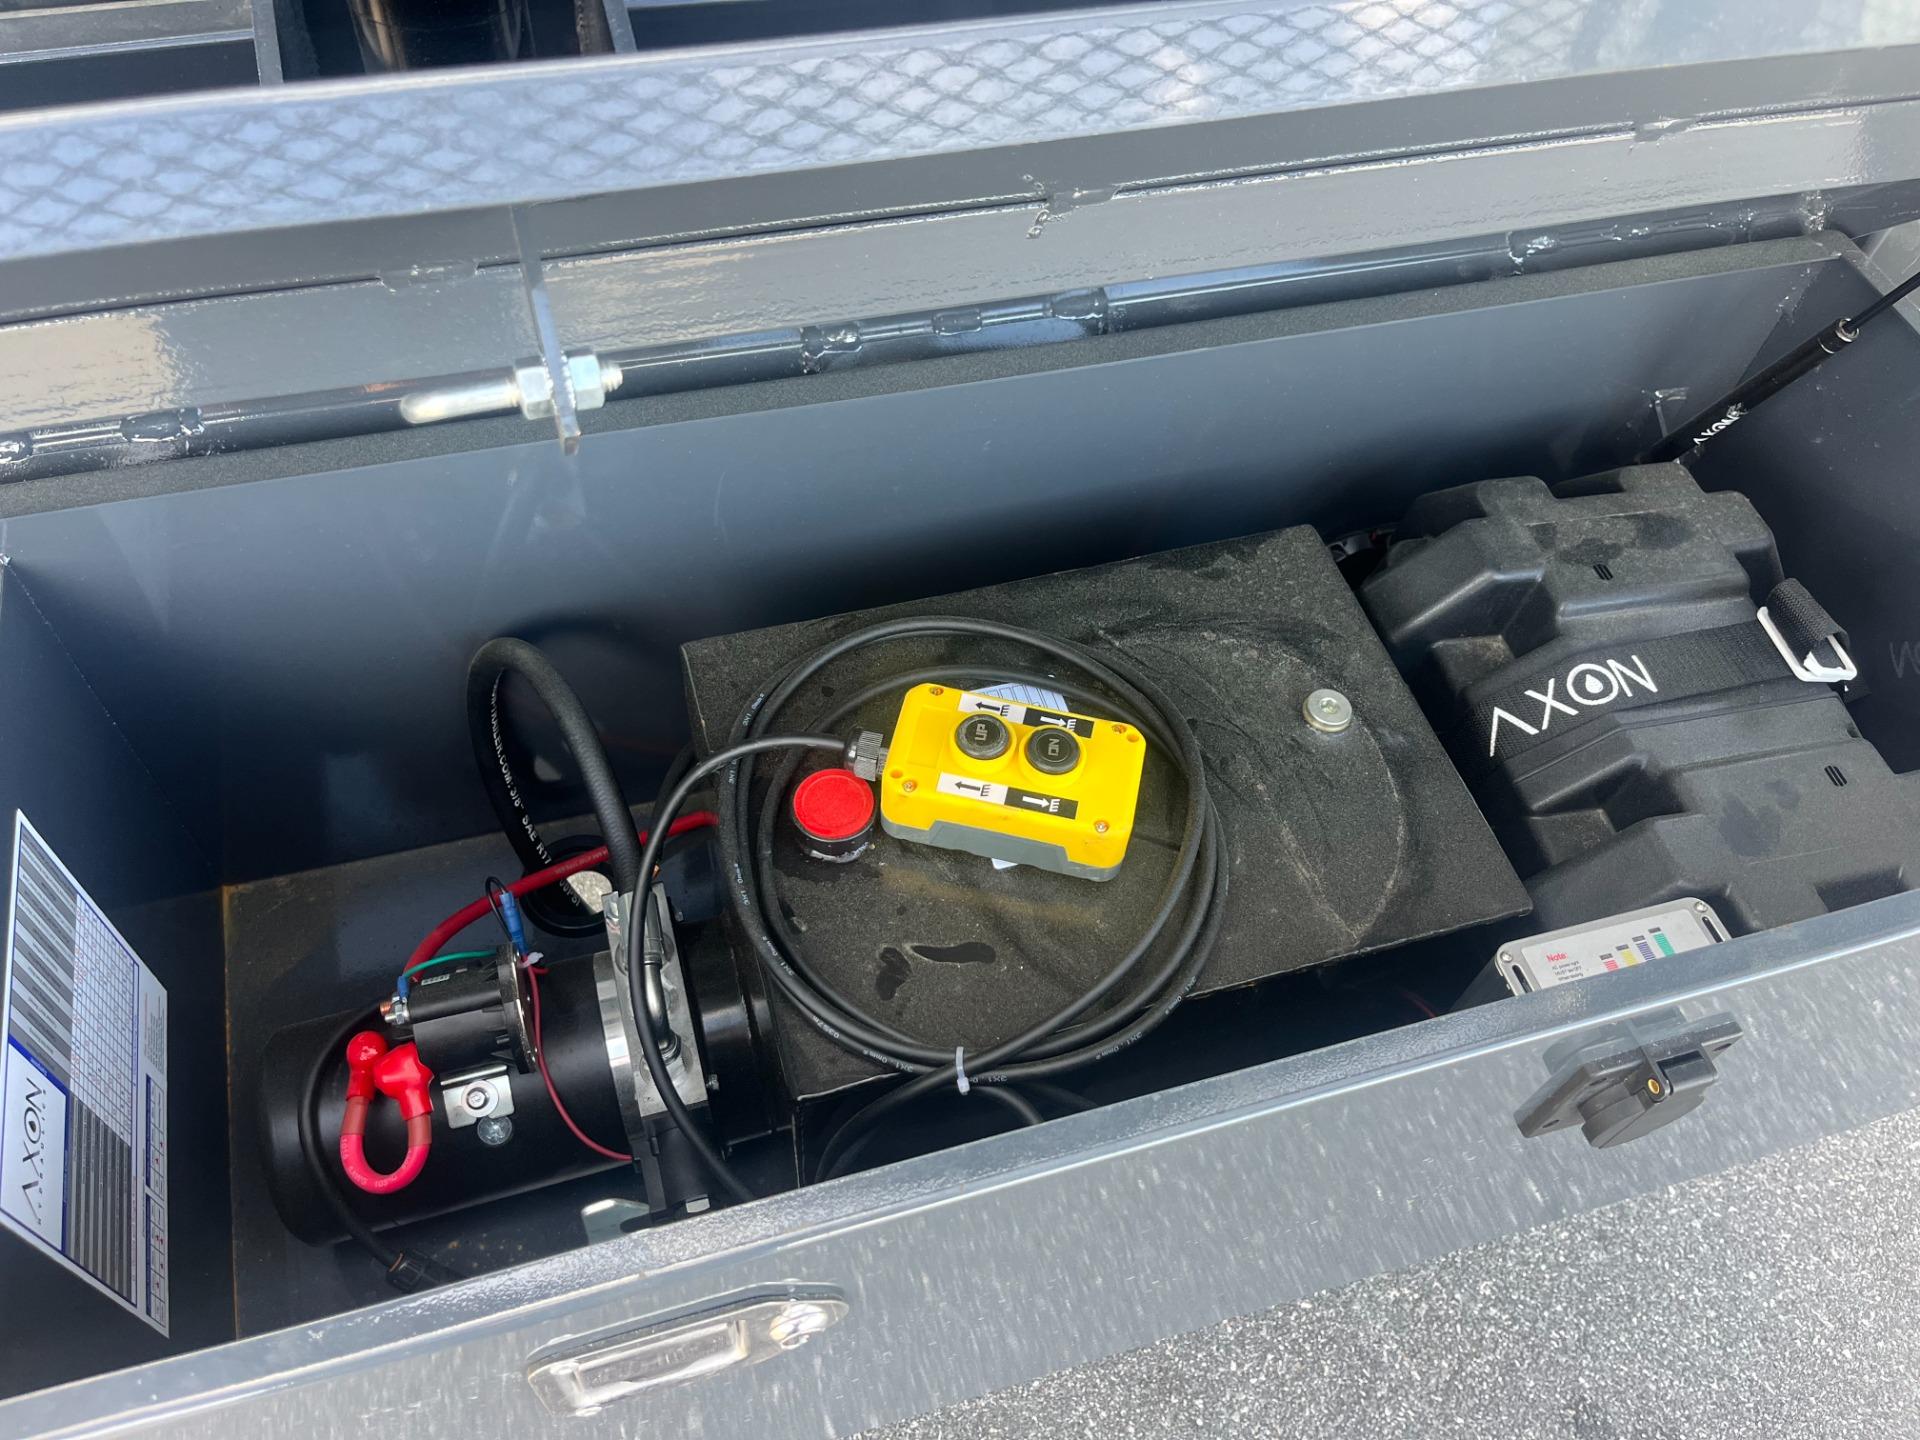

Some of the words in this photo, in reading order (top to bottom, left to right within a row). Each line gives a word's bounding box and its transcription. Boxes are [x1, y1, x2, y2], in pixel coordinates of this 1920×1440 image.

[974, 723, 988, 742] UP
[1489, 655, 1658, 757] AXON
[522, 816, 537, 842] SAE
[22, 1077, 42, 1221] AXON
